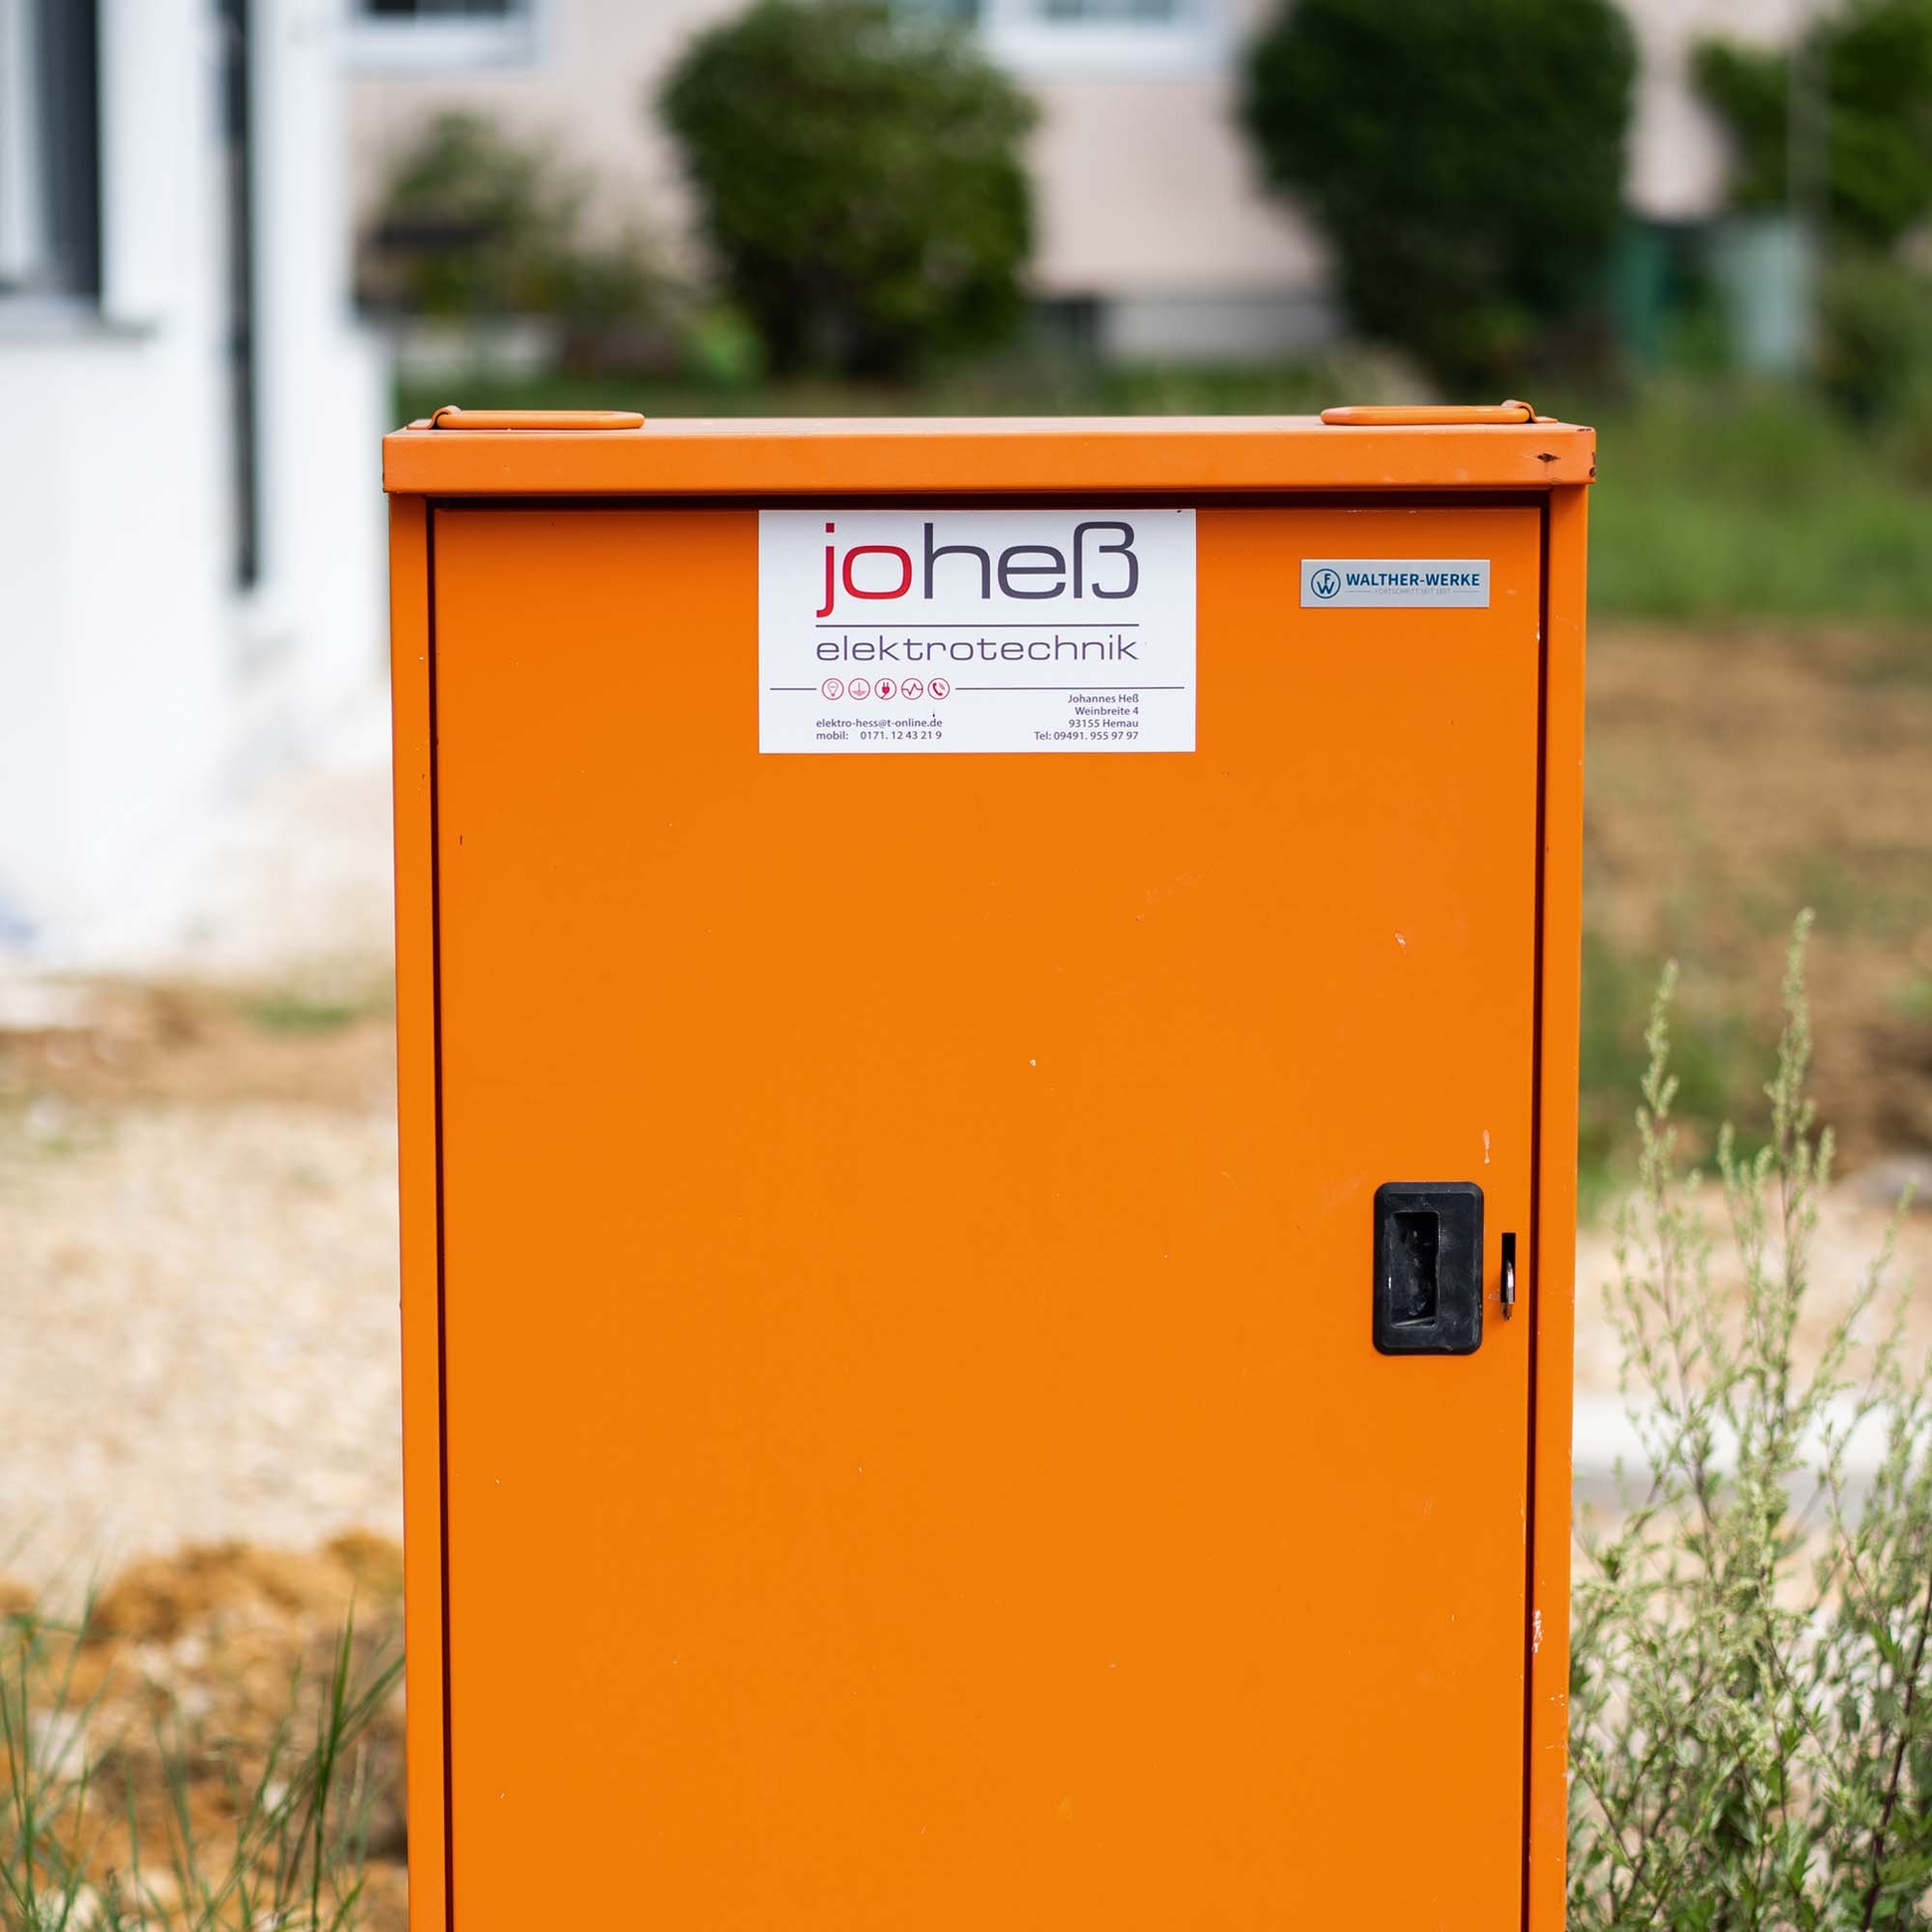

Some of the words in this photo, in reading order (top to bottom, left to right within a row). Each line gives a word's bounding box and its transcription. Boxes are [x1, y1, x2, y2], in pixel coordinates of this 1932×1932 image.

[816, 521, 1140, 618] joheß
[1345, 573, 1481, 587] WALTHER-WERKE
[816, 633, 1139, 661] elektrotechnik
[1068, 694, 1116, 704] Johannes
[1118, 694, 1139, 703] Heß
[1075, 706, 1130, 716] Weinbreite
[1132, 706, 1139, 716] 4
[816, 718, 943, 728] elektro-hess@t-online.de
[1068, 718, 1100, 728] 93155
[1102, 718, 1139, 728] Hemau
[816, 730, 848, 740] mobil:
[859, 731, 888, 740] 0171.
[891, 730, 903, 740] 12
[905, 730, 918, 740] 43
[1034, 731, 1052, 741] Tel:
[1053, 731, 1087, 741] 09491.
[1089, 731, 1109, 741] 955
[1110, 731, 1124, 741] 97
[1125, 731, 1139, 741] 97
